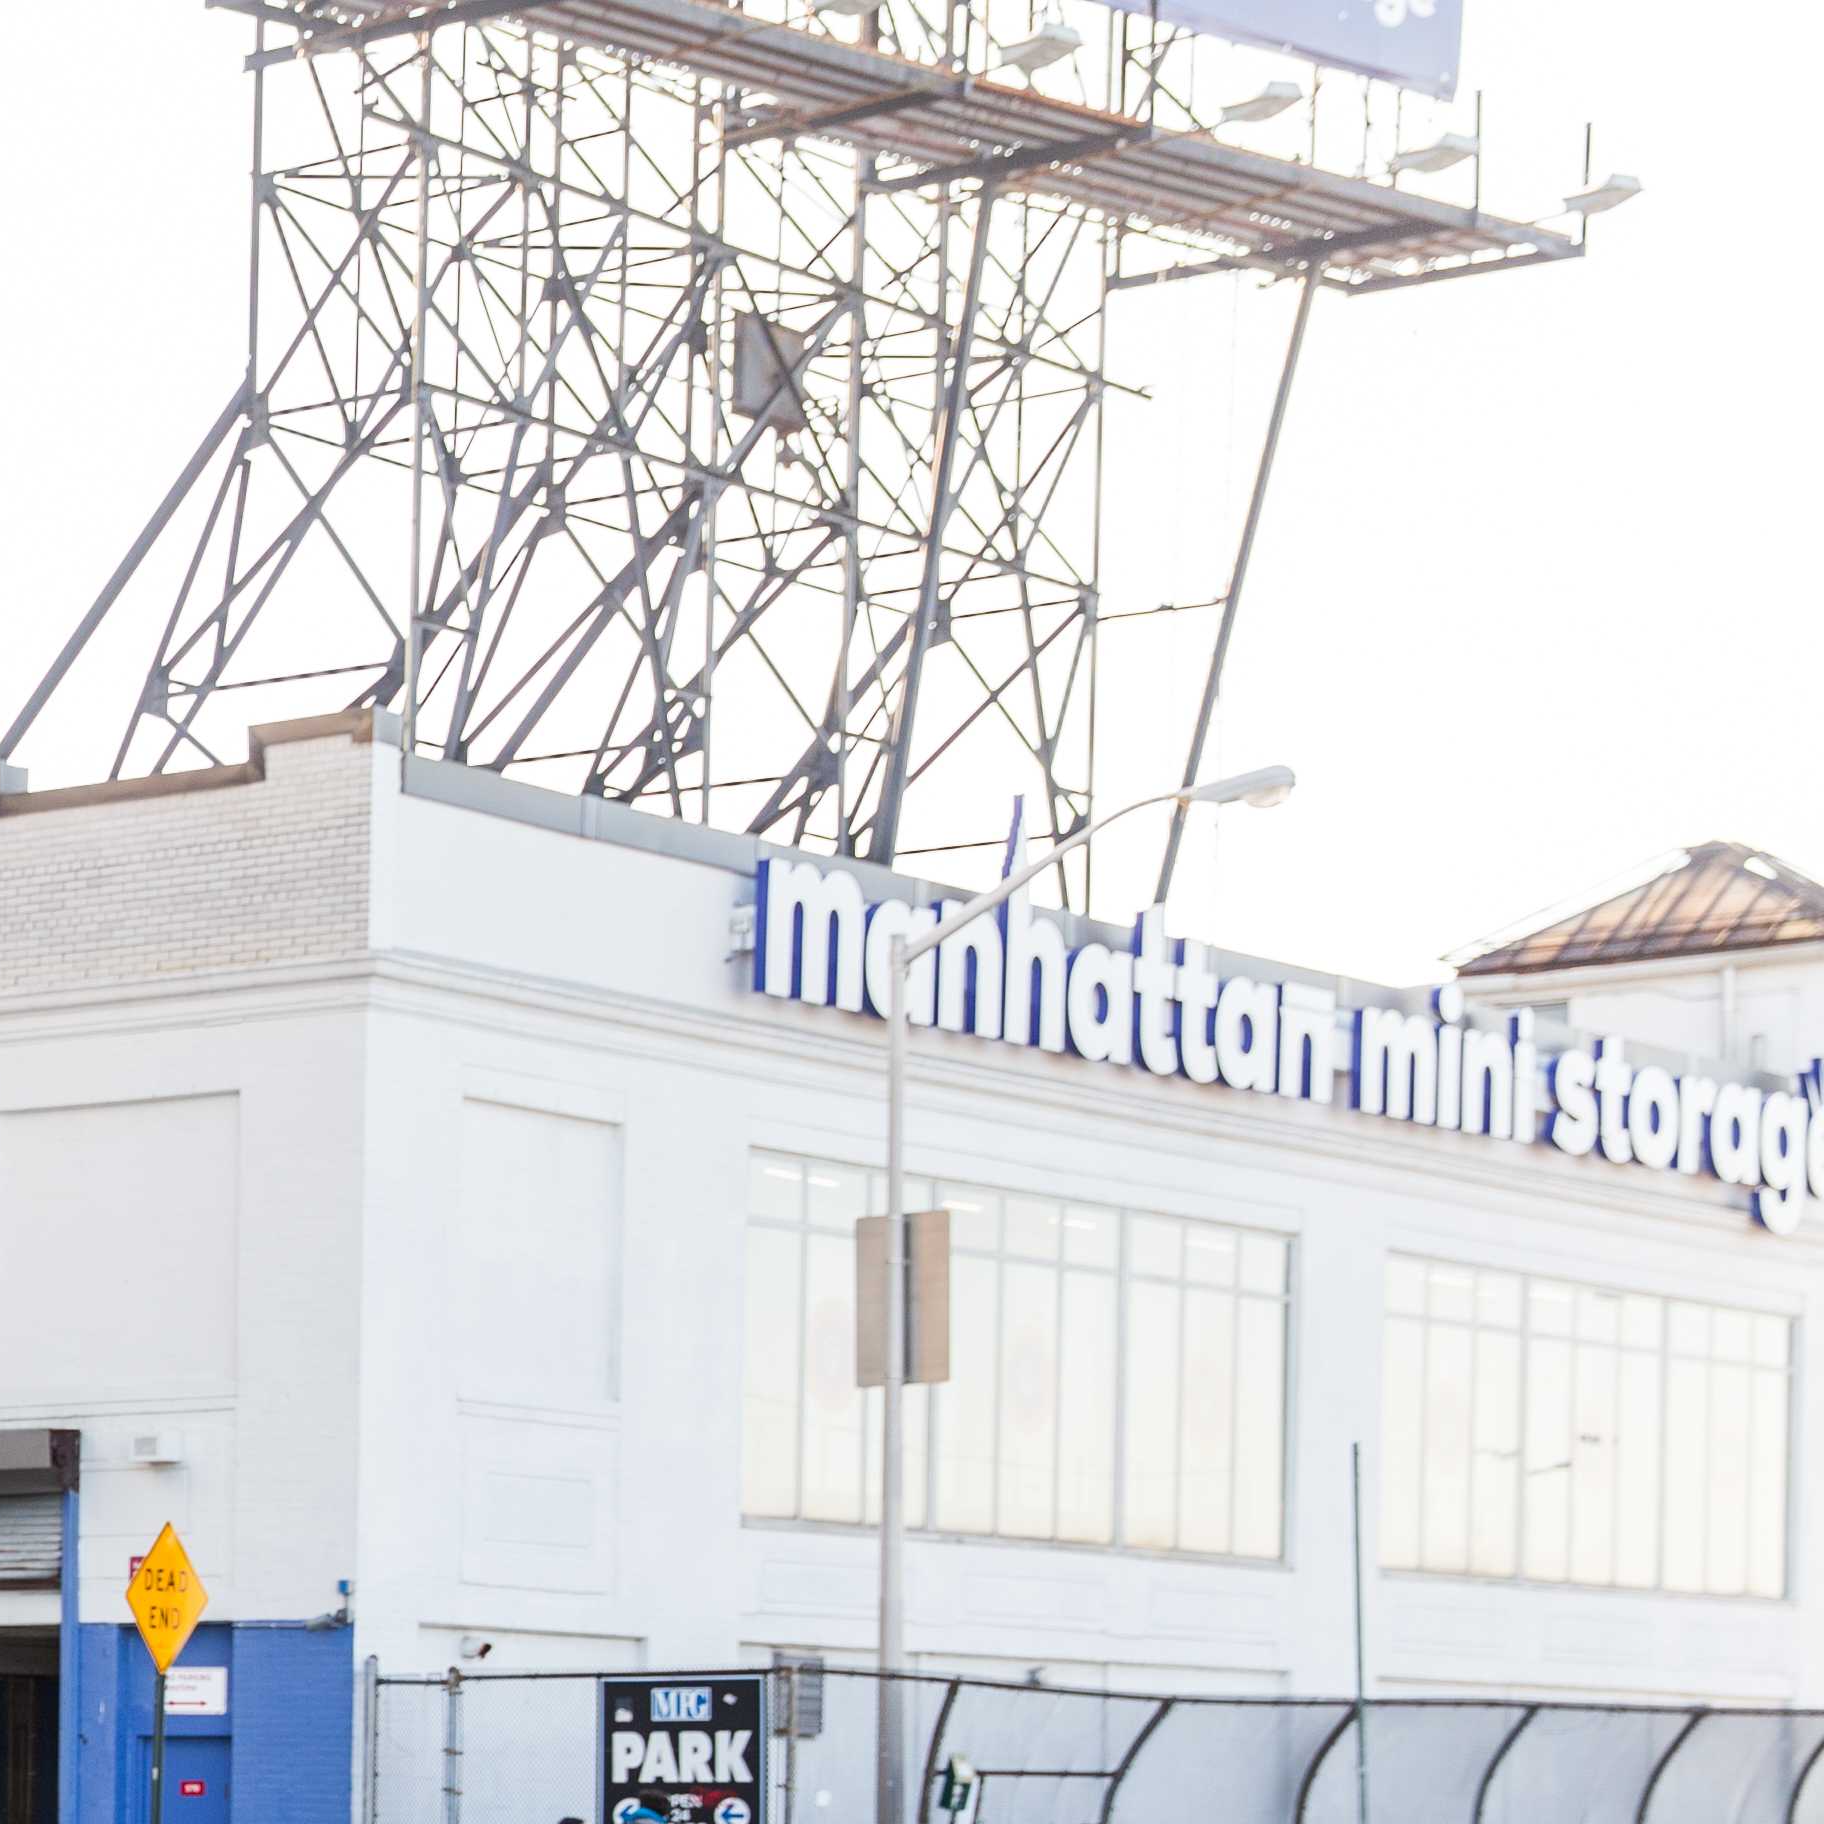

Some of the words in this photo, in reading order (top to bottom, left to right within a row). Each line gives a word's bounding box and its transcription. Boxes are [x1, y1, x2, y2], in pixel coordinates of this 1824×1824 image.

[754, 796, 1337, 1104] manhattan
[1350, 982, 1536, 1145] mini
[1548, 1034, 1824, 1235] storag
[144, 1568, 189, 1593] DEAD
[149, 1605, 181, 1630] END
[611, 1730, 754, 1784] PARK
[668, 1793, 704, 1808] PEN
